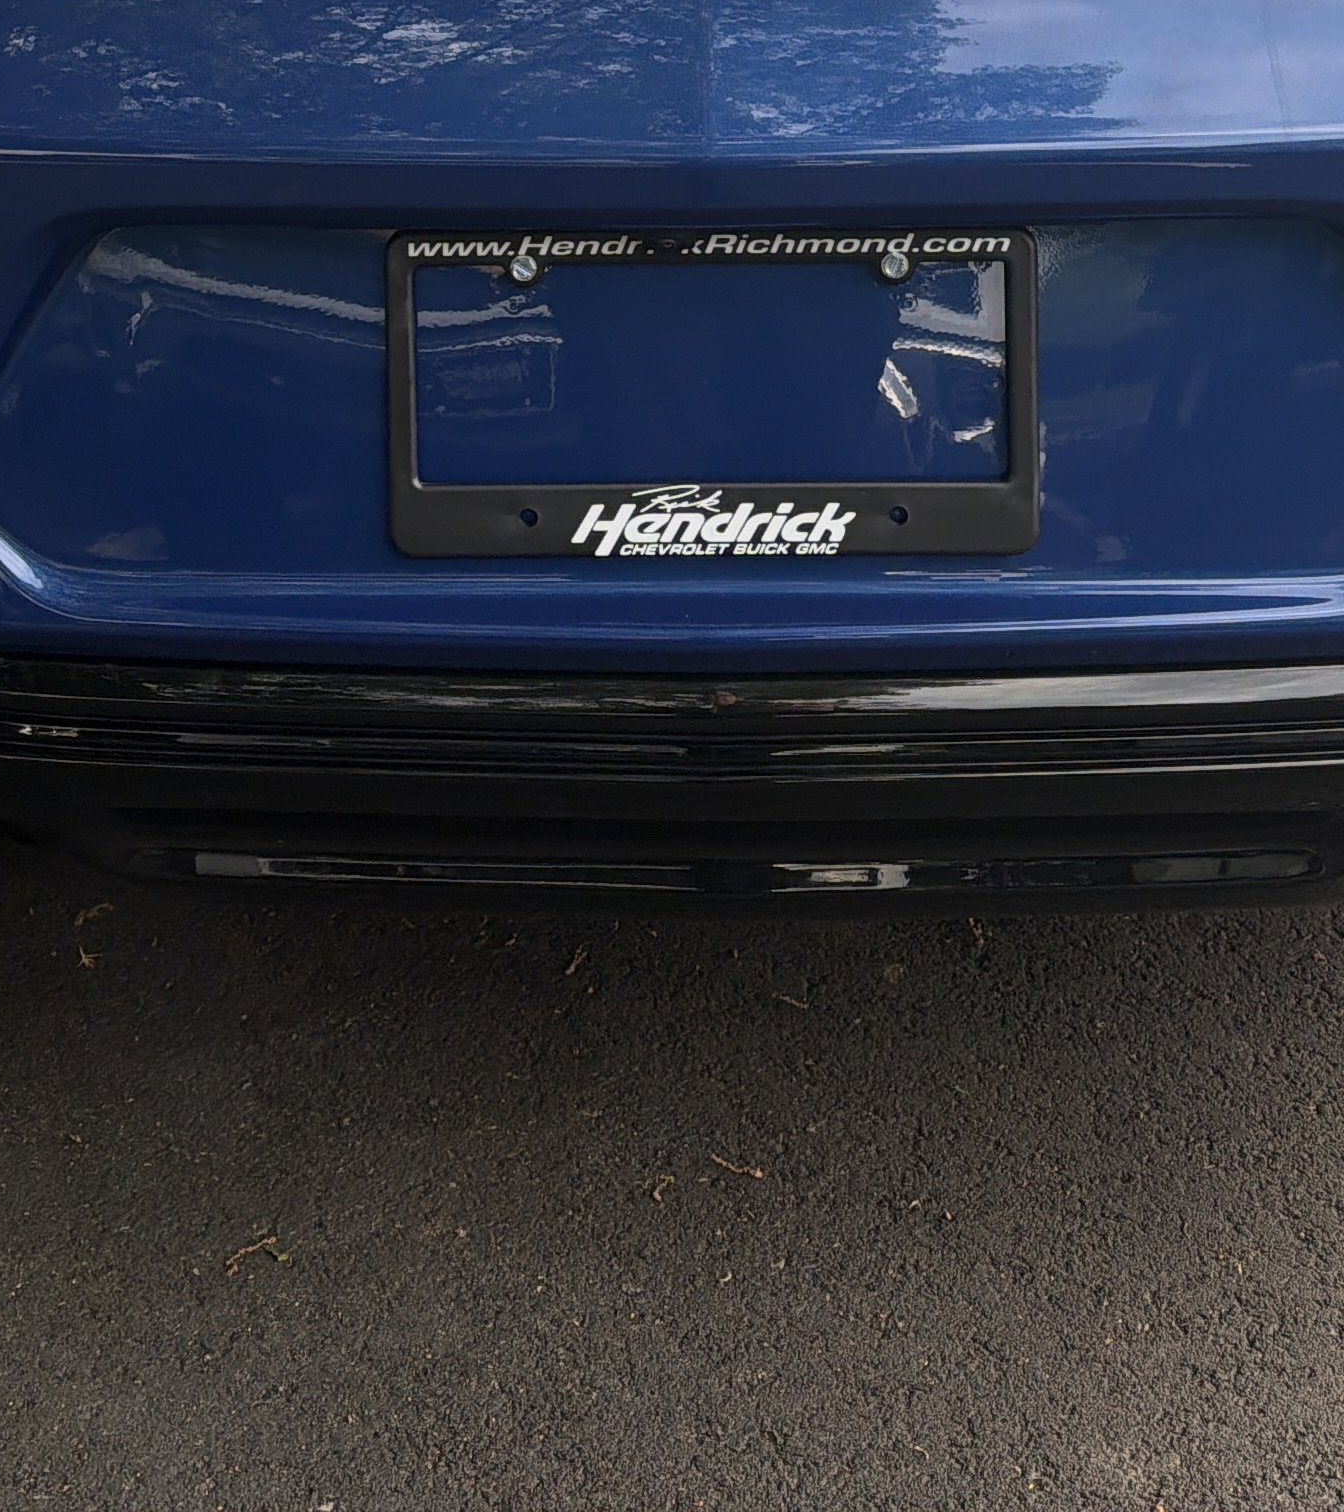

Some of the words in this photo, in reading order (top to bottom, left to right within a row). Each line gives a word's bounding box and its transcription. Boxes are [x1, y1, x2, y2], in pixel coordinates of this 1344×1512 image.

[571, 502, 856, 557] Hendrick
[619, 542, 727, 556] CHEVROLET
[732, 542, 789, 556] BUICK
[795, 542, 840, 556] GMC
